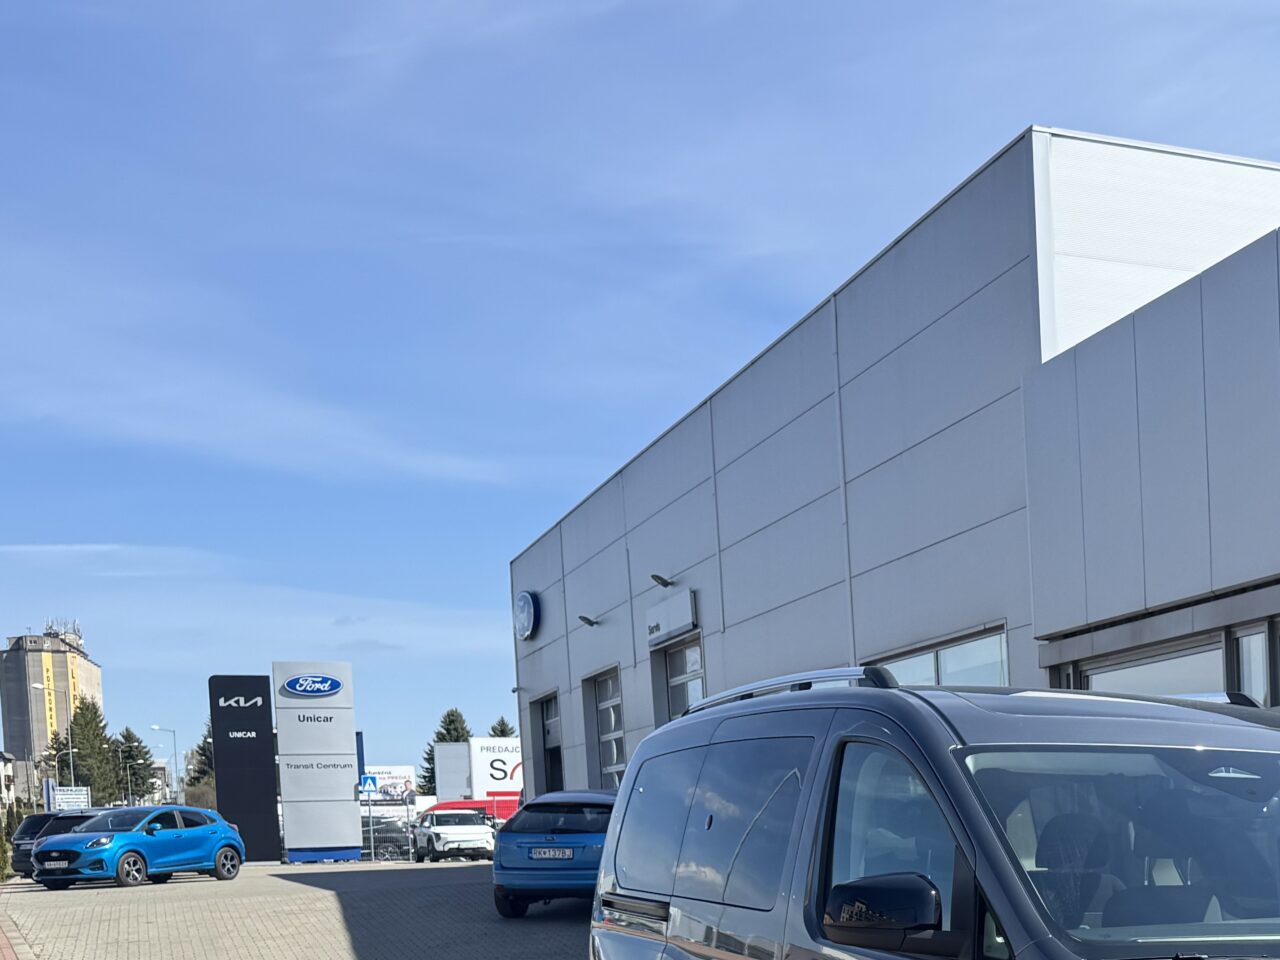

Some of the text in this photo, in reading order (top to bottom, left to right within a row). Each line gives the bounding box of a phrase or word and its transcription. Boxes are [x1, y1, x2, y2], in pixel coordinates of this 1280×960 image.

[296, 676, 331, 691] Ford
[218, 696, 263, 707] KIA
[297, 714, 334, 723] Unicar
